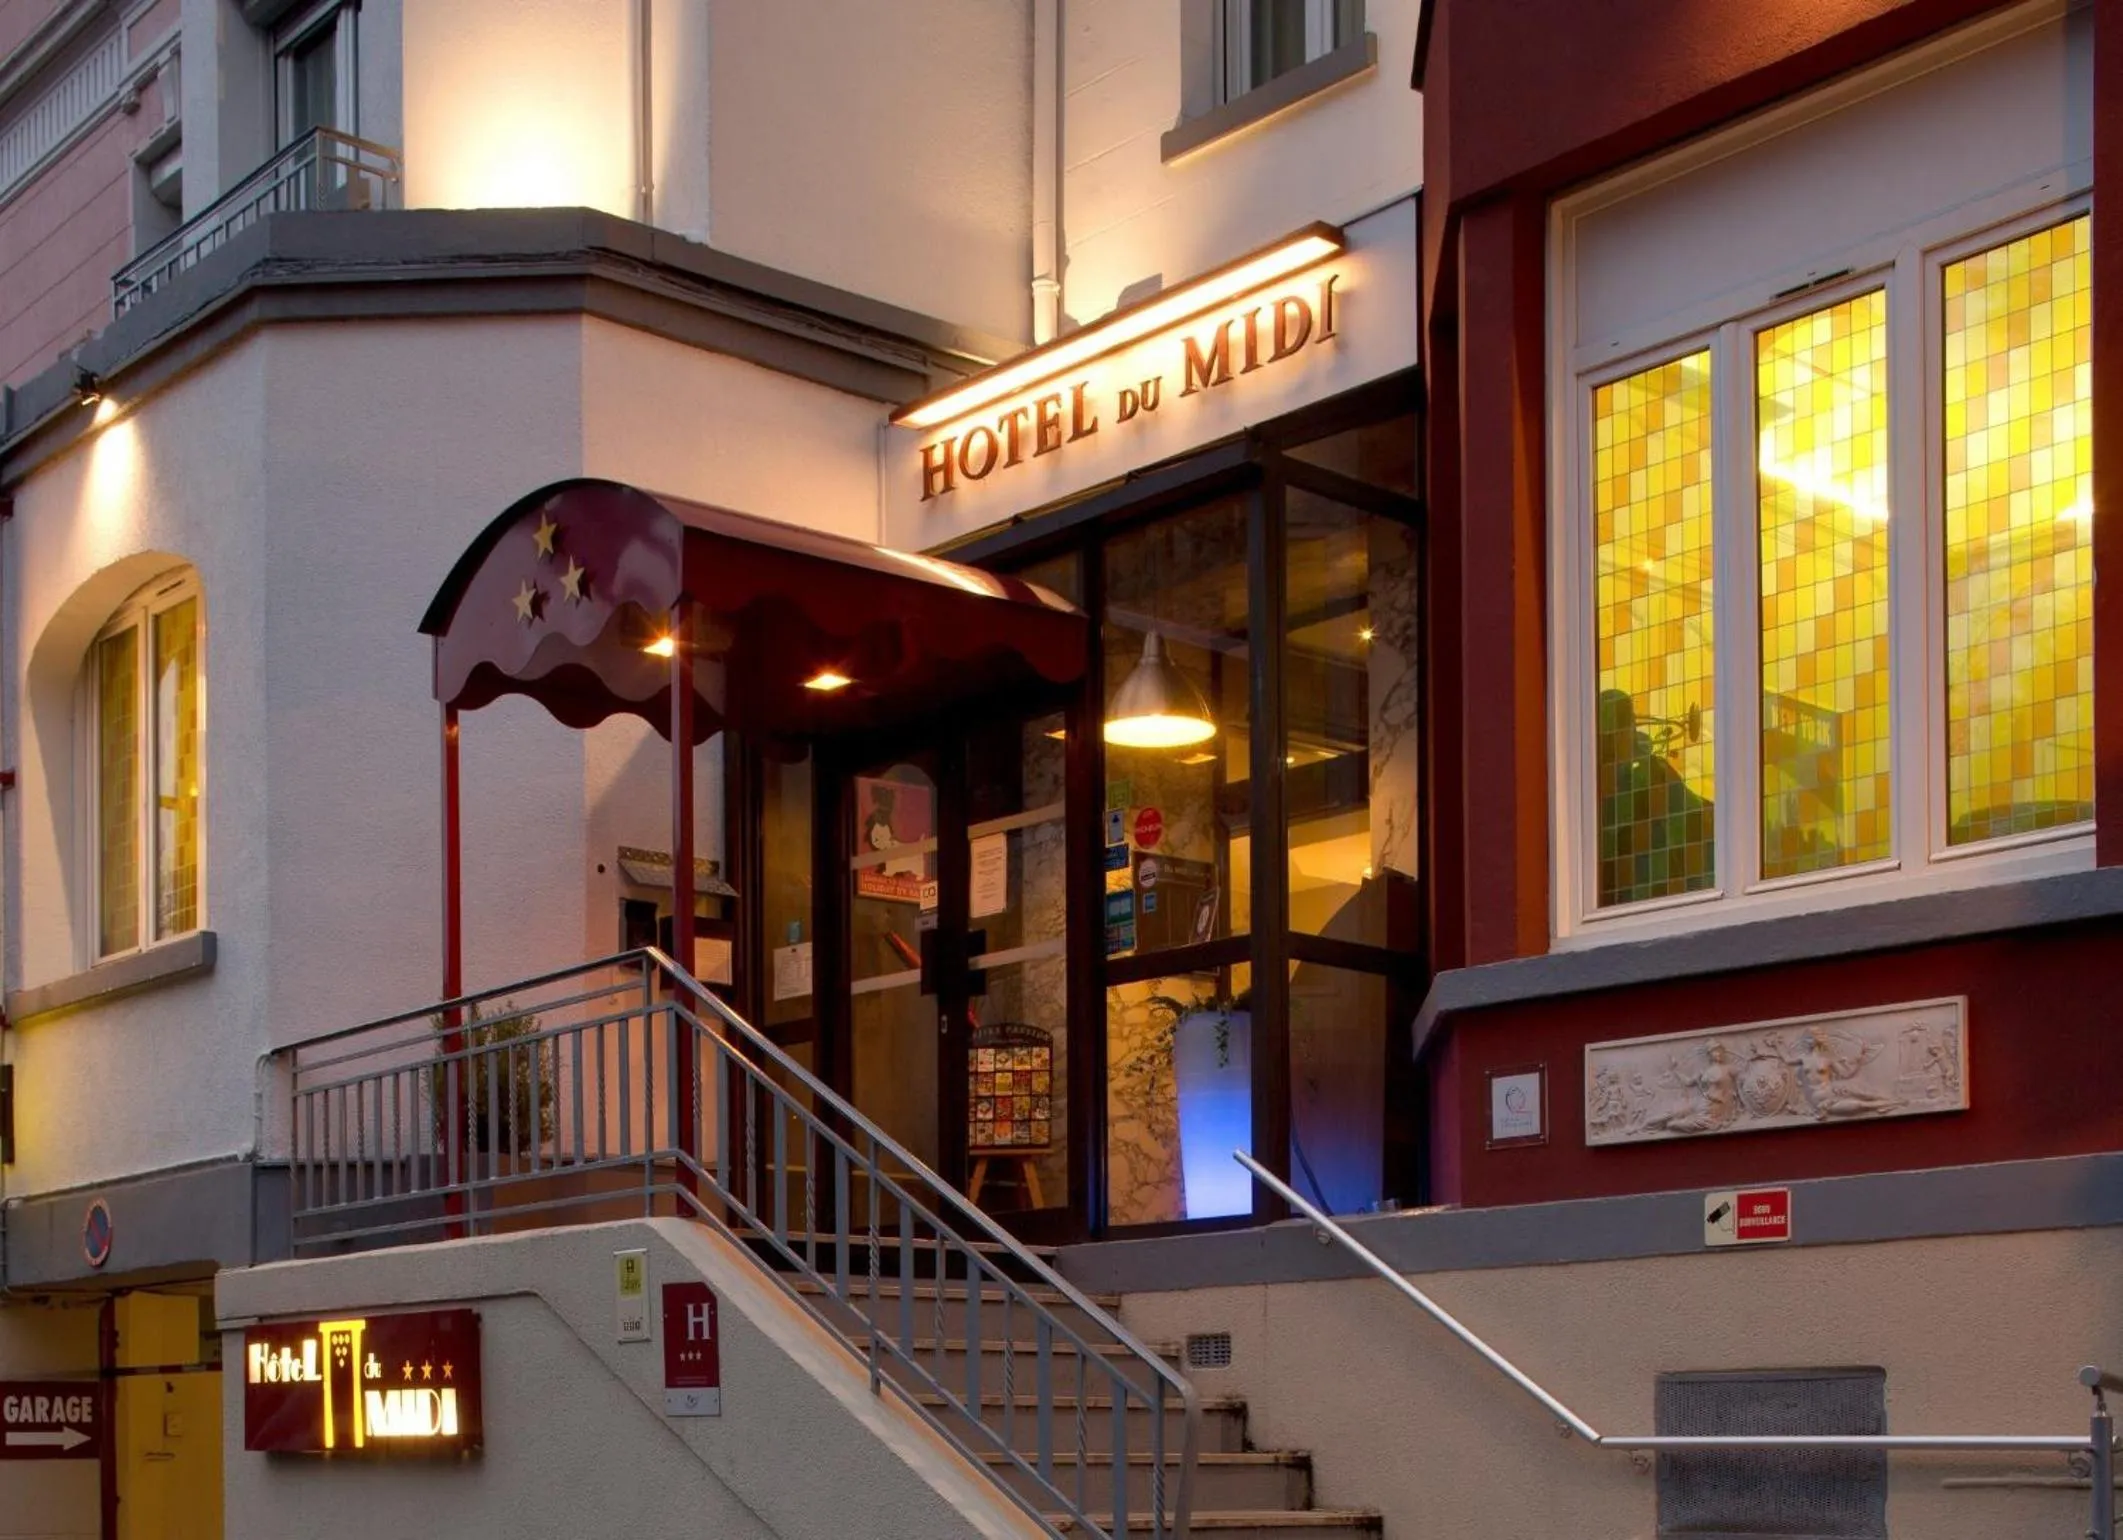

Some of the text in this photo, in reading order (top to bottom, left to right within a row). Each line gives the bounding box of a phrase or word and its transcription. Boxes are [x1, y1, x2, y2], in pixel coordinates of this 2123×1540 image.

[920, 274, 1340, 502] HOTEL DU MIDI
[685, 1303, 711, 1340] H
[364, 1353, 382, 1379] du
[3, 1395, 93, 1423] GARAGE
[364, 1388, 459, 1437] MIDI
